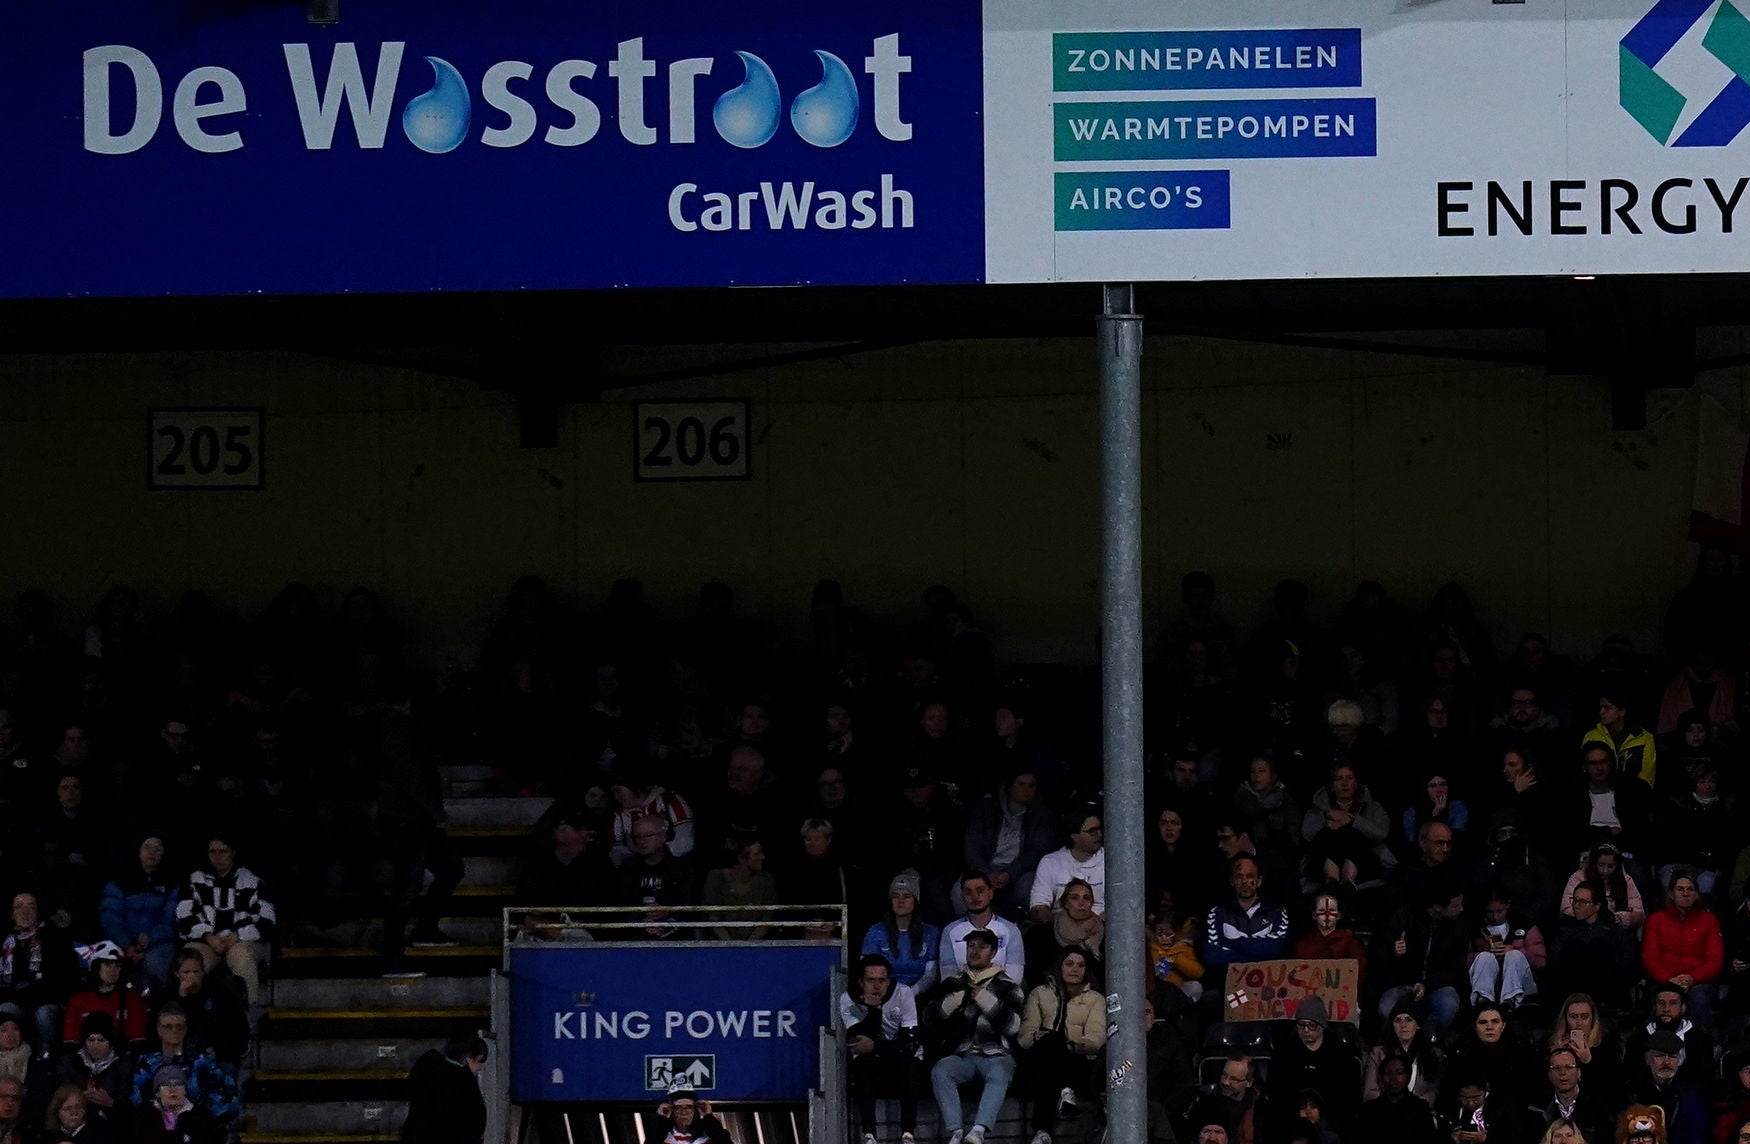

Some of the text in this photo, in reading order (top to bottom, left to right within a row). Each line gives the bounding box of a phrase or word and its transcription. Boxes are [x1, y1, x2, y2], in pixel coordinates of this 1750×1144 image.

[1068, 45, 1338, 73] ZONNEPANELEN
[83, 44, 247, 155] De
[1069, 114, 1355, 141] WARMTEPOMPEN
[668, 174, 914, 232] CarWash
[1070, 186, 1203, 210] AIRCO'S
[156, 424, 253, 476] 205
[643, 416, 739, 467] 206
[555, 1010, 797, 1039] KING POWER
